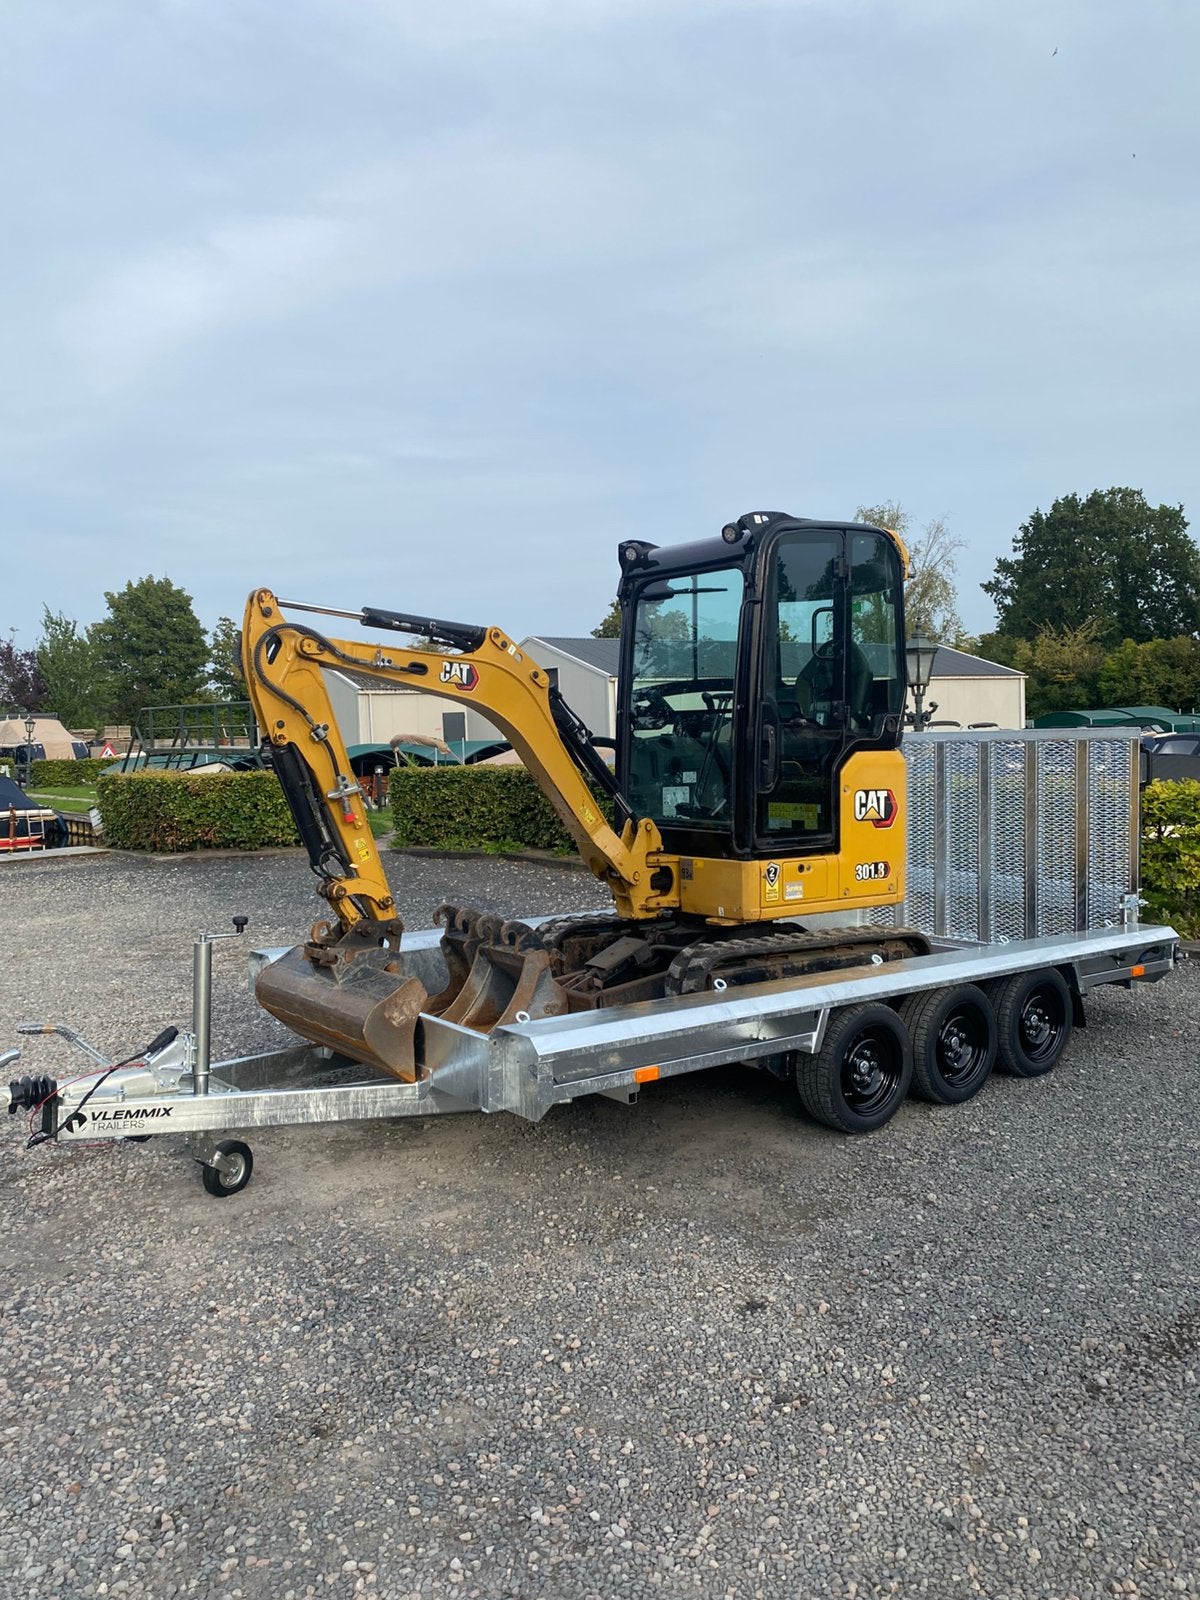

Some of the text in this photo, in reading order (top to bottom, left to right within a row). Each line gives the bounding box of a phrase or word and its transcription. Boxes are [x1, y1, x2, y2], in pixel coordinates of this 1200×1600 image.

[440, 661, 470, 684] CAT
[855, 790, 888, 820] CAT
[769, 867, 775, 877] 2
[856, 862, 885, 879] 301.8
[91, 1107, 173, 1120] VLEMMIX
[91, 1120, 146, 1131] TRAILERS
